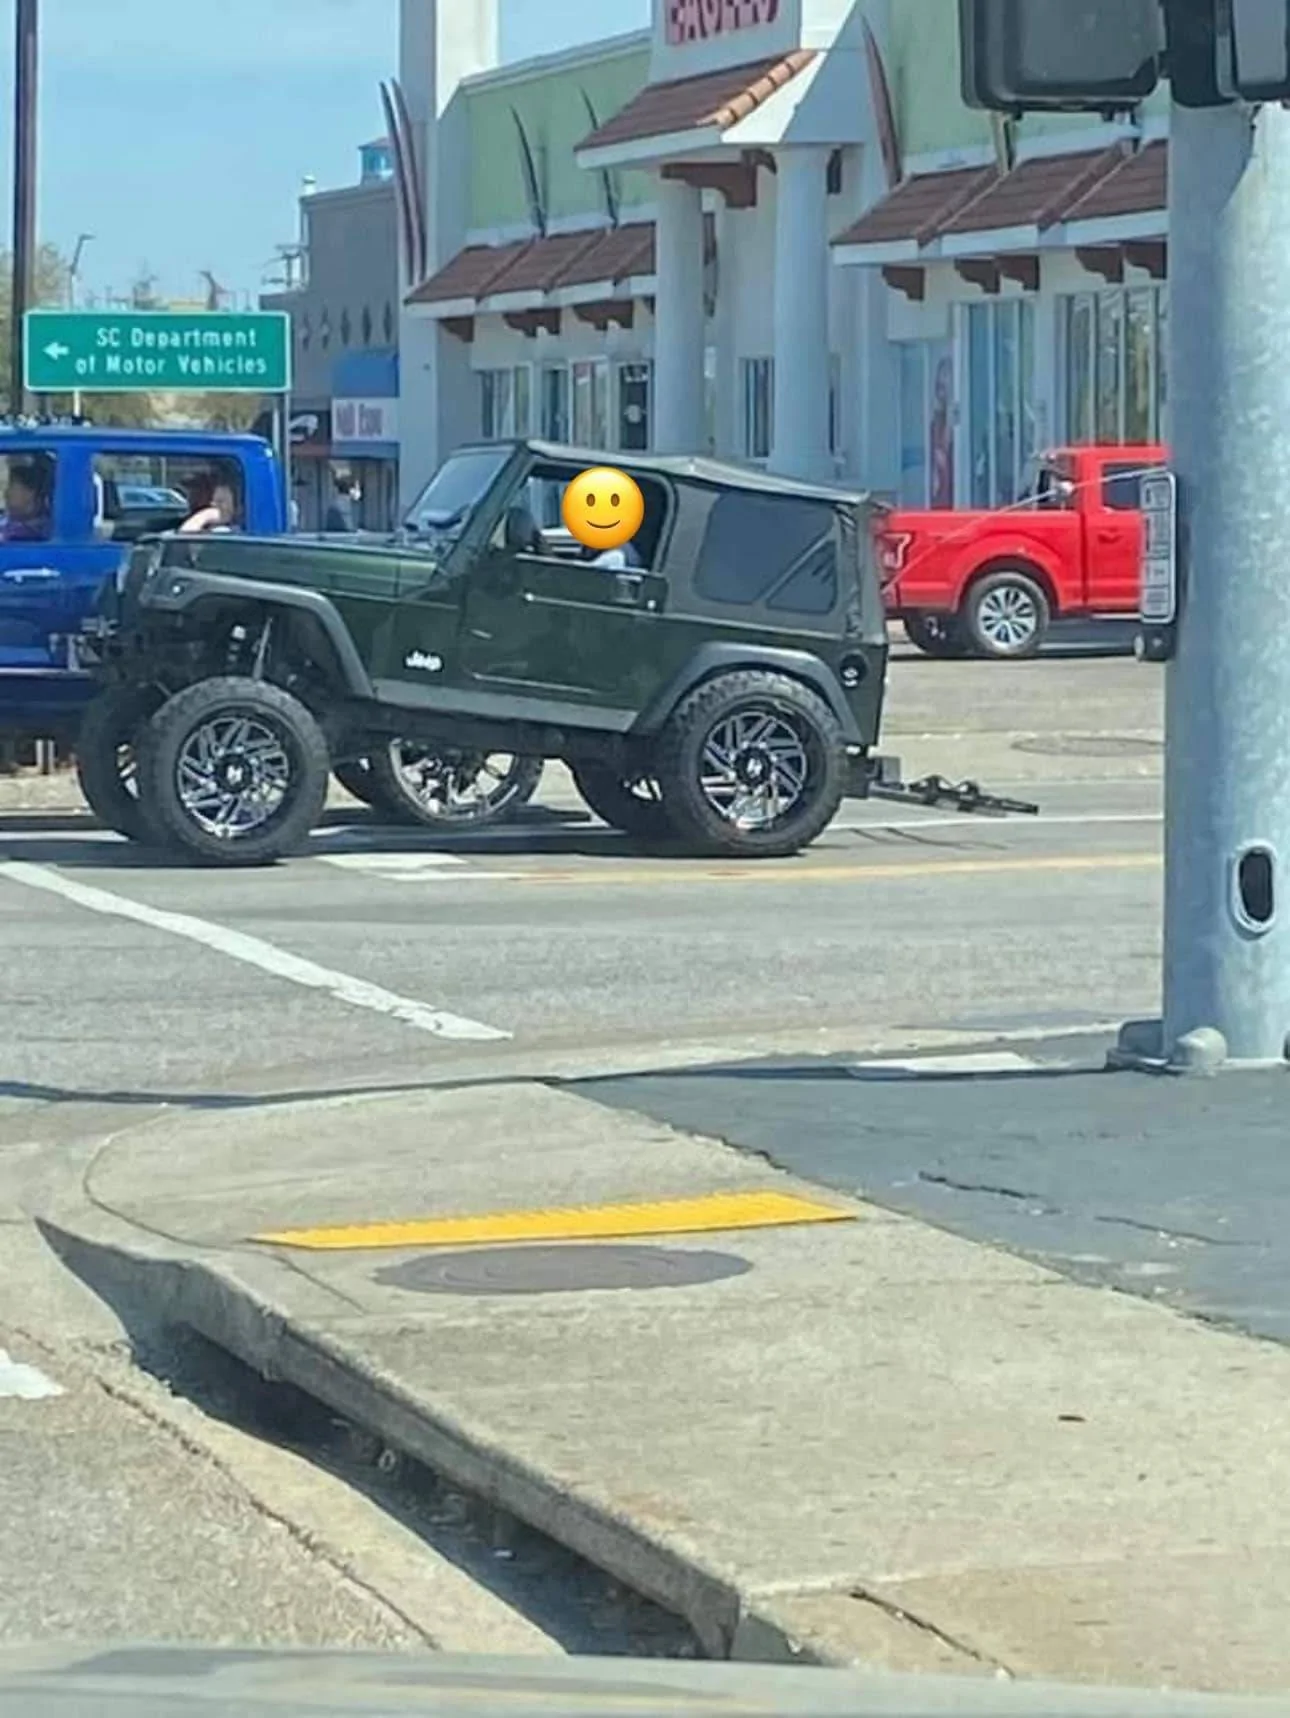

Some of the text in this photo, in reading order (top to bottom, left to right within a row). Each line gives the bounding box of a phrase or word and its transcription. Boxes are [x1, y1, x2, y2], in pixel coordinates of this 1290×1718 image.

[96, 327, 257, 349] SC Department
[75, 355, 268, 375] of Motor Vehicles
